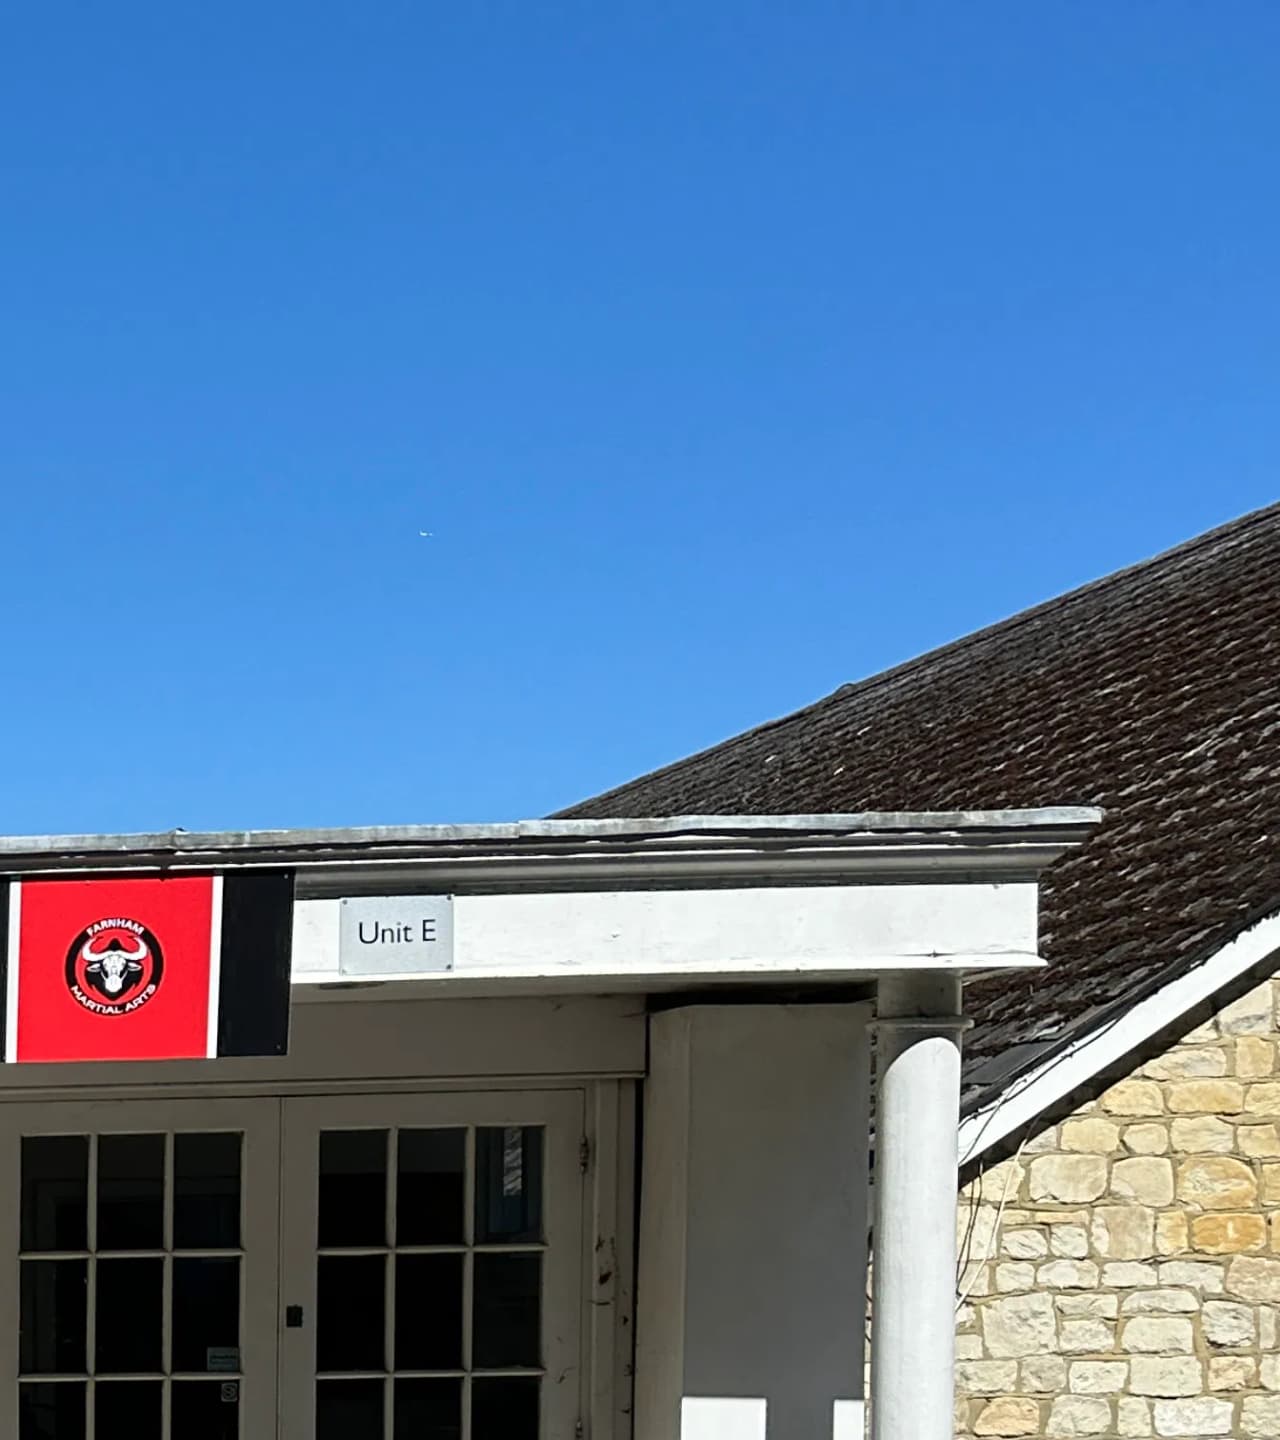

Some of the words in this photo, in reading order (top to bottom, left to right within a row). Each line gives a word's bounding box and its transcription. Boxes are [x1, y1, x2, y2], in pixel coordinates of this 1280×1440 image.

[86, 918, 145, 937] FARNHAM
[358, 920, 414, 945] Unit
[422, 919, 437, 942] E
[71, 985, 123, 1014] MARTIAL
[125, 984, 156, 1012] ARTS
